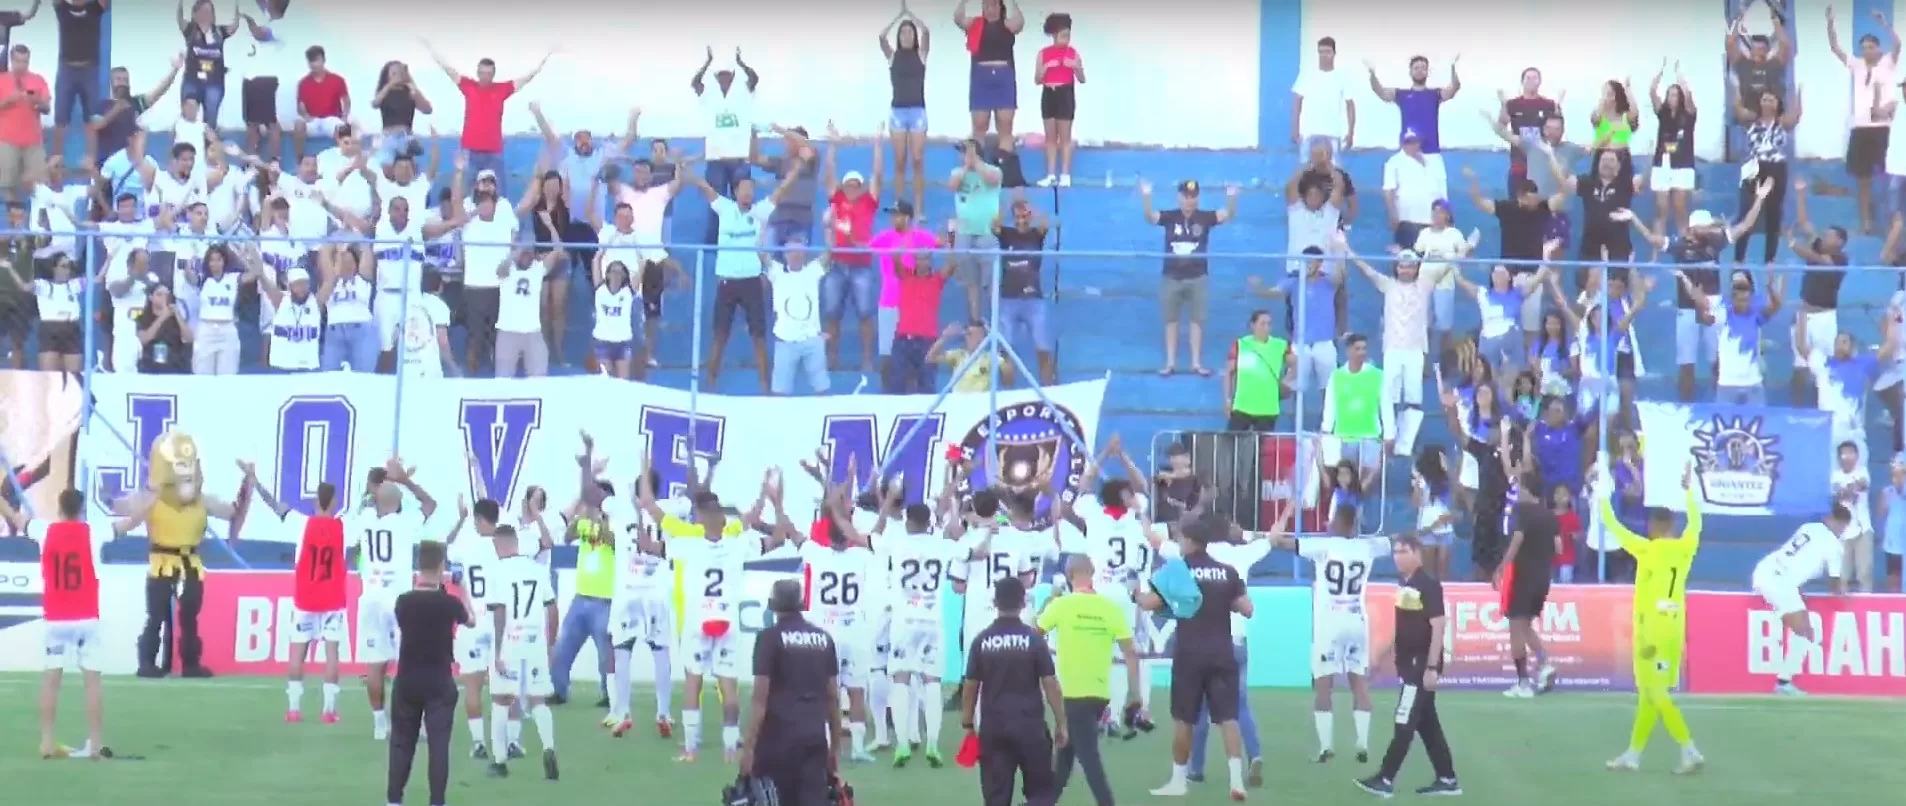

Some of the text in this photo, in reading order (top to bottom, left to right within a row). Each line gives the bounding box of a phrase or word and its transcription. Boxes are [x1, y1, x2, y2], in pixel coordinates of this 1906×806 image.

[365, 528, 393, 562] 10
[1107, 536, 1127, 568] 3
[52, 552, 82, 591] 16
[308, 545, 334, 581] 19
[900, 558, 943, 592] 23
[1324, 560, 1366, 595] 92
[468, 564, 486, 598] 6
[703, 568, 725, 597] 2
[819, 571, 860, 605] 26
[1667, 566, 1678, 598] 1
[511, 579, 538, 619] 17
[780, 631, 828, 648] NORTH
[980, 633, 1030, 649] NORTH
